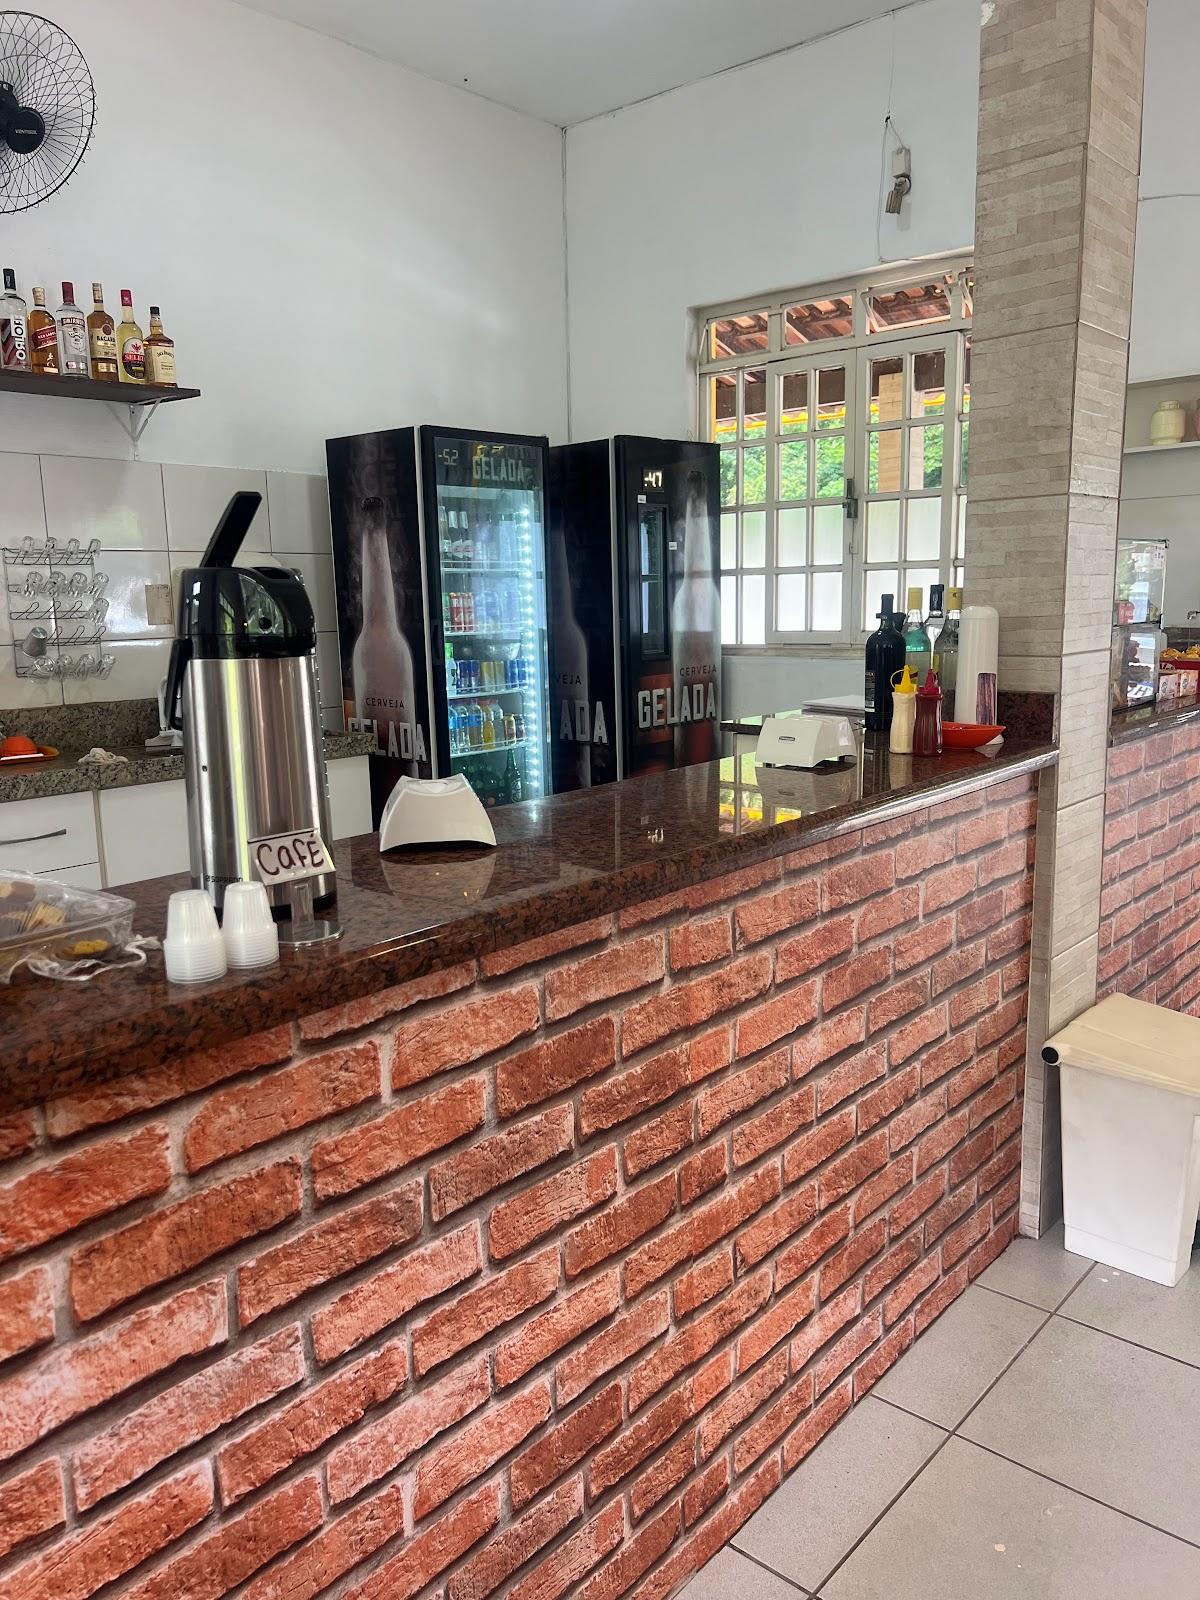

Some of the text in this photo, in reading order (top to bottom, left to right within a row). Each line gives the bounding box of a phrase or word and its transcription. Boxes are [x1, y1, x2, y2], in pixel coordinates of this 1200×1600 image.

[472, 455, 525, 482] GELADA
[555, 674, 582, 685] VEJA
[680, 664, 717, 677] CERVEJA
[365, 697, 405, 709] CERVEJA
[637, 682, 717, 729] GELADA
[559, 699, 608, 744] ADA
